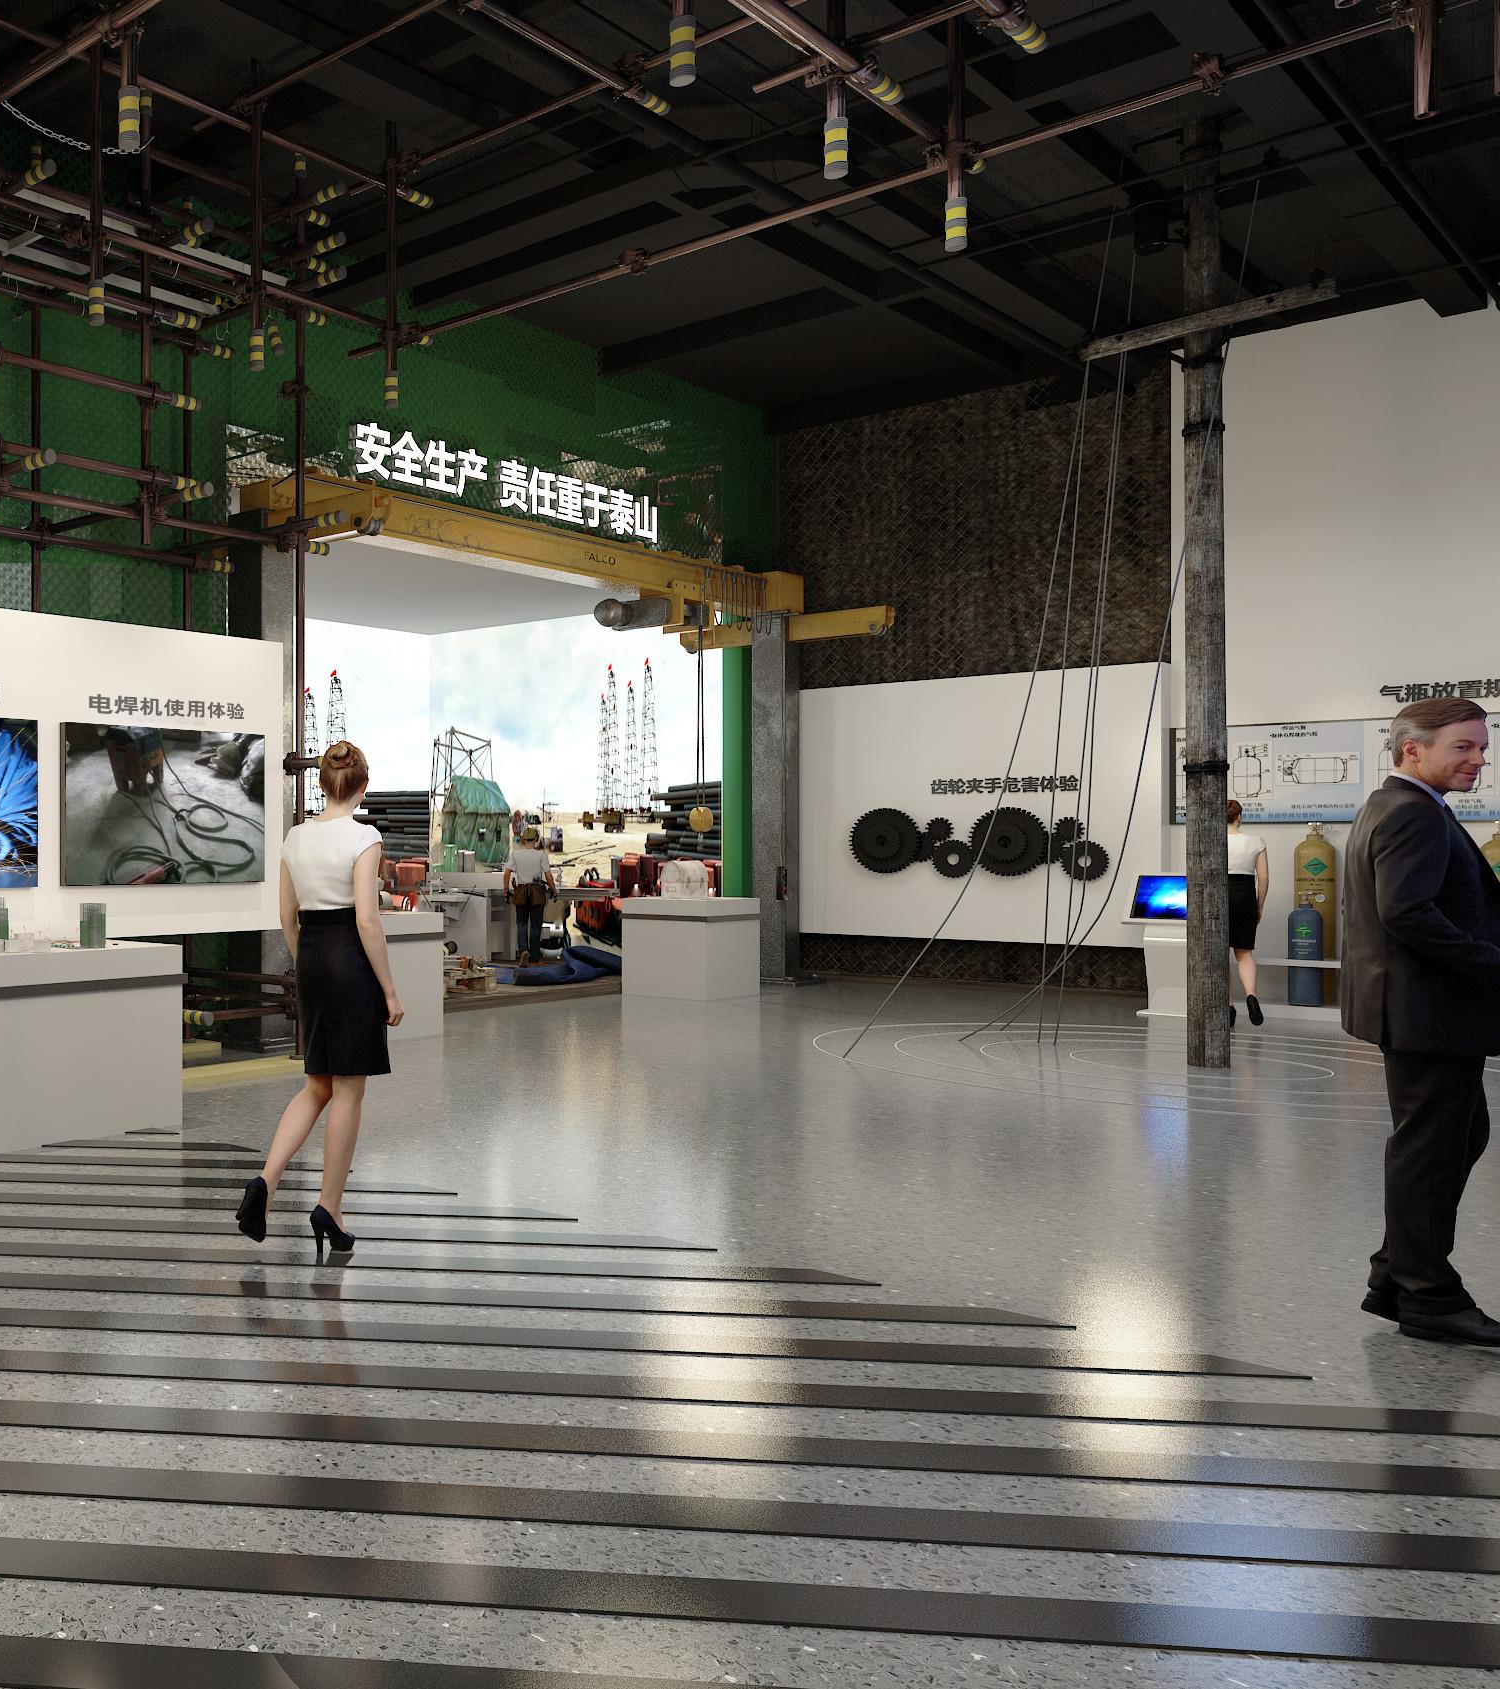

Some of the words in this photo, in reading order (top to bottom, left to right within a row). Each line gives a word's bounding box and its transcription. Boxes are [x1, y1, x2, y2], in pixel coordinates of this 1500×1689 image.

[355, 422, 488, 497] 安全生产
[499, 459, 658, 543] 责任重于泰山
[584, 551, 616, 566] FALCO
[88, 693, 246, 720] 电焊机使用体验
[930, 775, 1079, 795] 齿轮夹手危害体验
